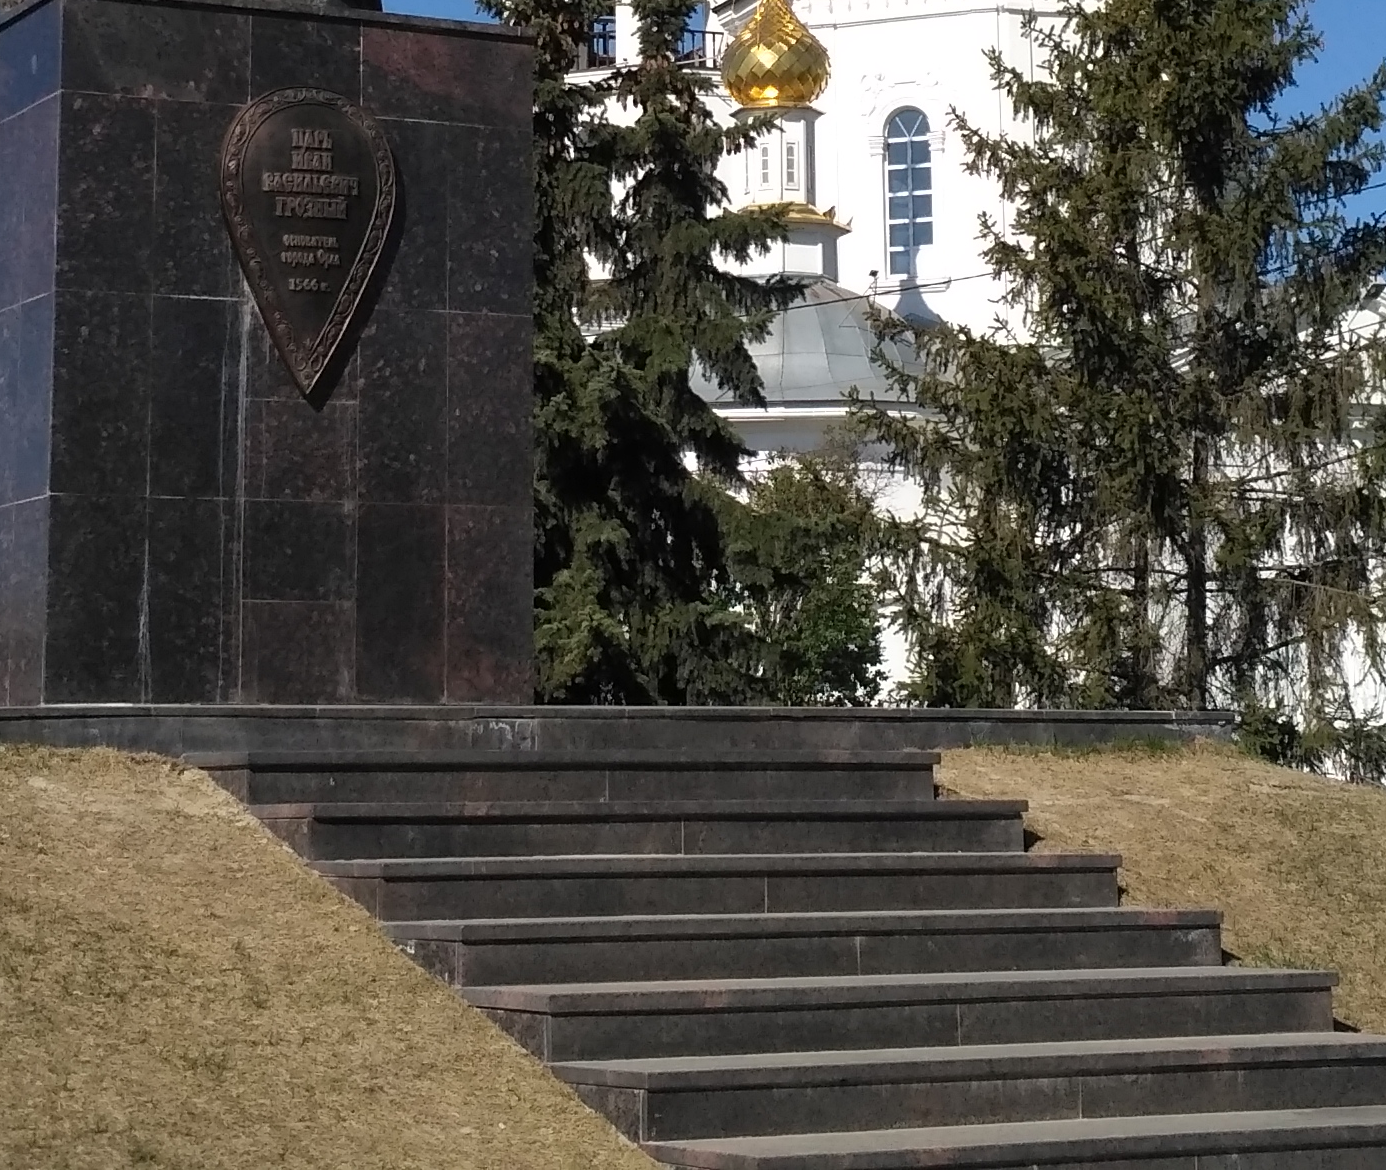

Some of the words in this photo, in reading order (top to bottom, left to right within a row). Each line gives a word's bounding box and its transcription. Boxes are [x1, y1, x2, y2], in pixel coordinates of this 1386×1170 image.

[291, 129, 333, 150] ЦАРЬ
[291, 151, 333, 170] ИВАН
[262, 172, 359, 195] ВАСИЛЬЕВИЧ
[288, 278, 319, 291] 1566
